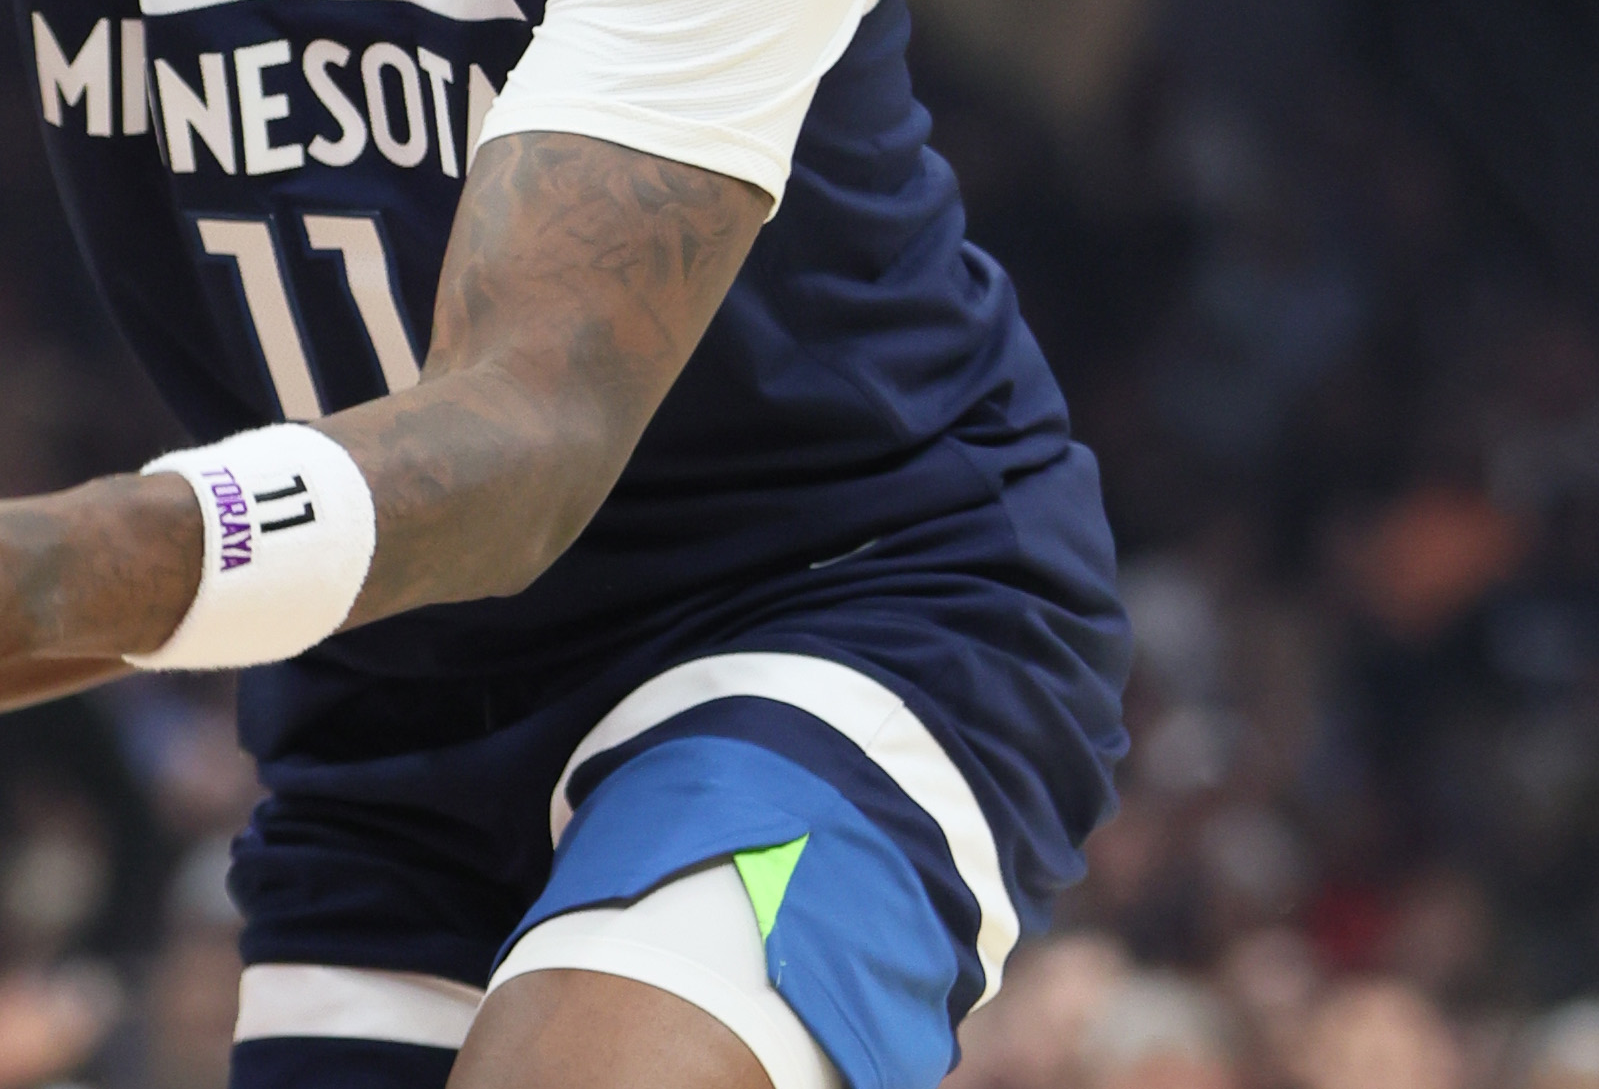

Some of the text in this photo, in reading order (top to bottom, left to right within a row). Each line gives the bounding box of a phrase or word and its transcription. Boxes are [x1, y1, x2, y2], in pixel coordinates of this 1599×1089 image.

[197, 214, 421, 420] 11
[201, 466, 252, 573] TORAYA
[253, 474, 316, 534] 11
